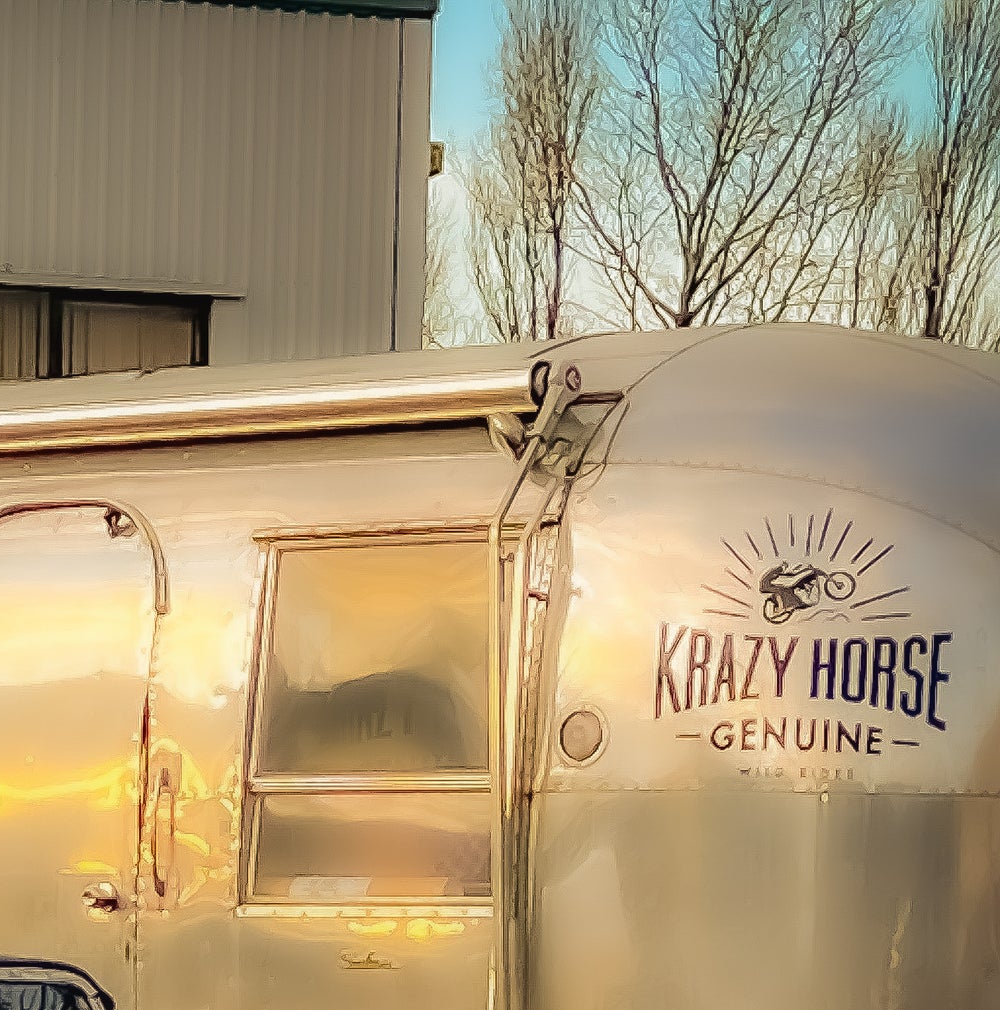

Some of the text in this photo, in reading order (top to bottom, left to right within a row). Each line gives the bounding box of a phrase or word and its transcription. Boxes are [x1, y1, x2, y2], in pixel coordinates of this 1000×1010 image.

[654, 622, 953, 731] KRAZY HORSE
[709, 717, 883, 754] GENUINE
